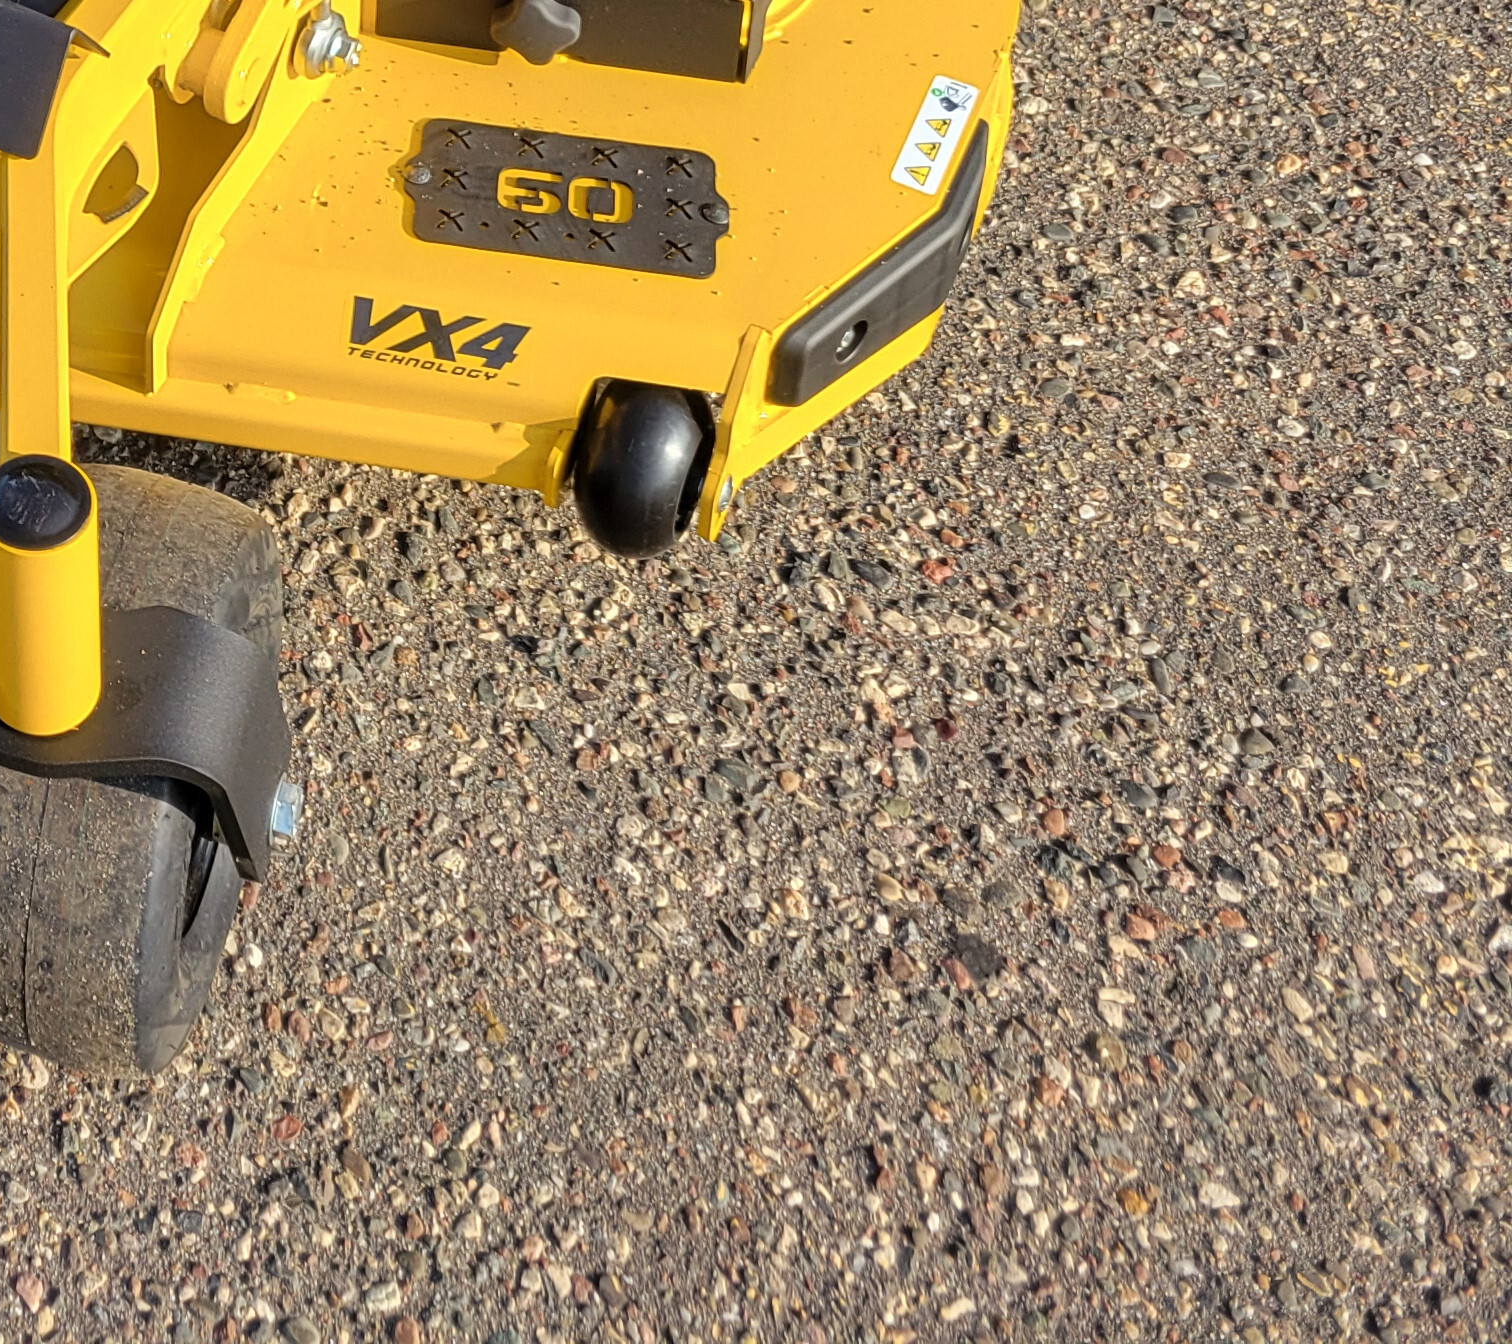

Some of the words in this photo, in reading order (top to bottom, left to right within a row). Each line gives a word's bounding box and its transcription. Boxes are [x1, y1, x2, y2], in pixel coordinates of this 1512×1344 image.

[496, 167, 634, 224] 60
[349, 295, 532, 370] VX4
[347, 346, 499, 381] TECHNOLOGY
